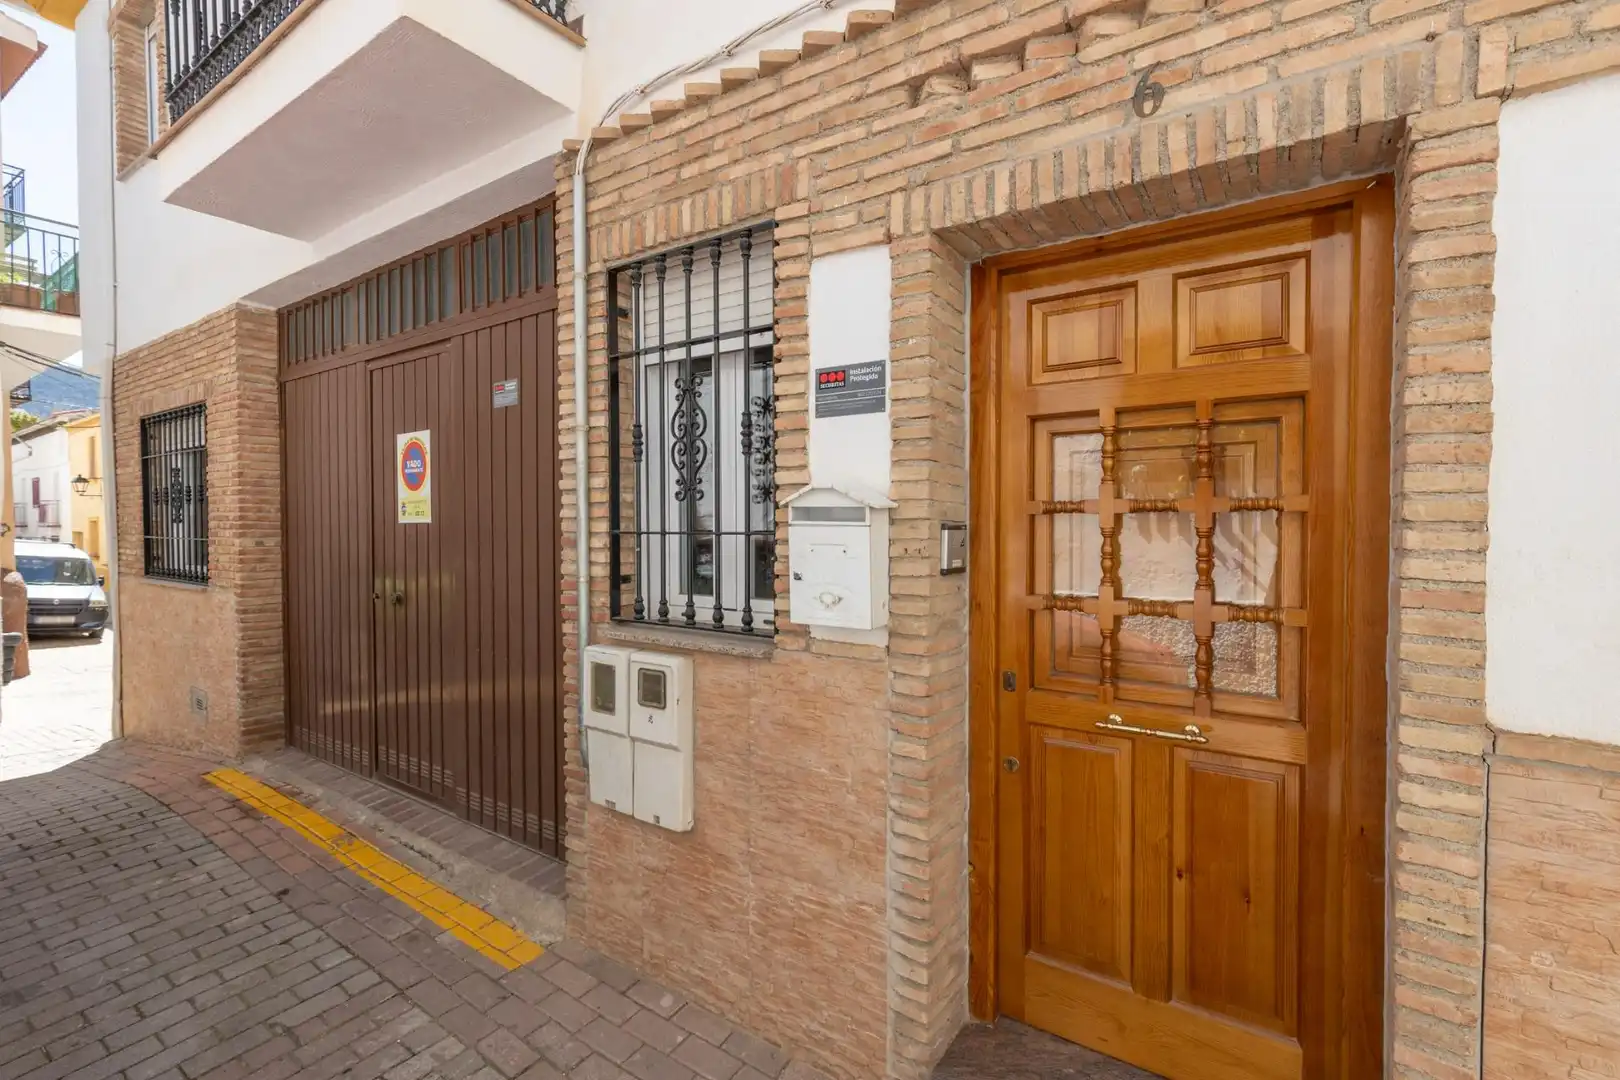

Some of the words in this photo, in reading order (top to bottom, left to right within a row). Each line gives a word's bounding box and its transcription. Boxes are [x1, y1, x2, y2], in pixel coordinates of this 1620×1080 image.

[1133, 69, 1165, 118] 6
[849, 365, 882, 375] Instalación
[849, 373, 879, 382] Protegida
